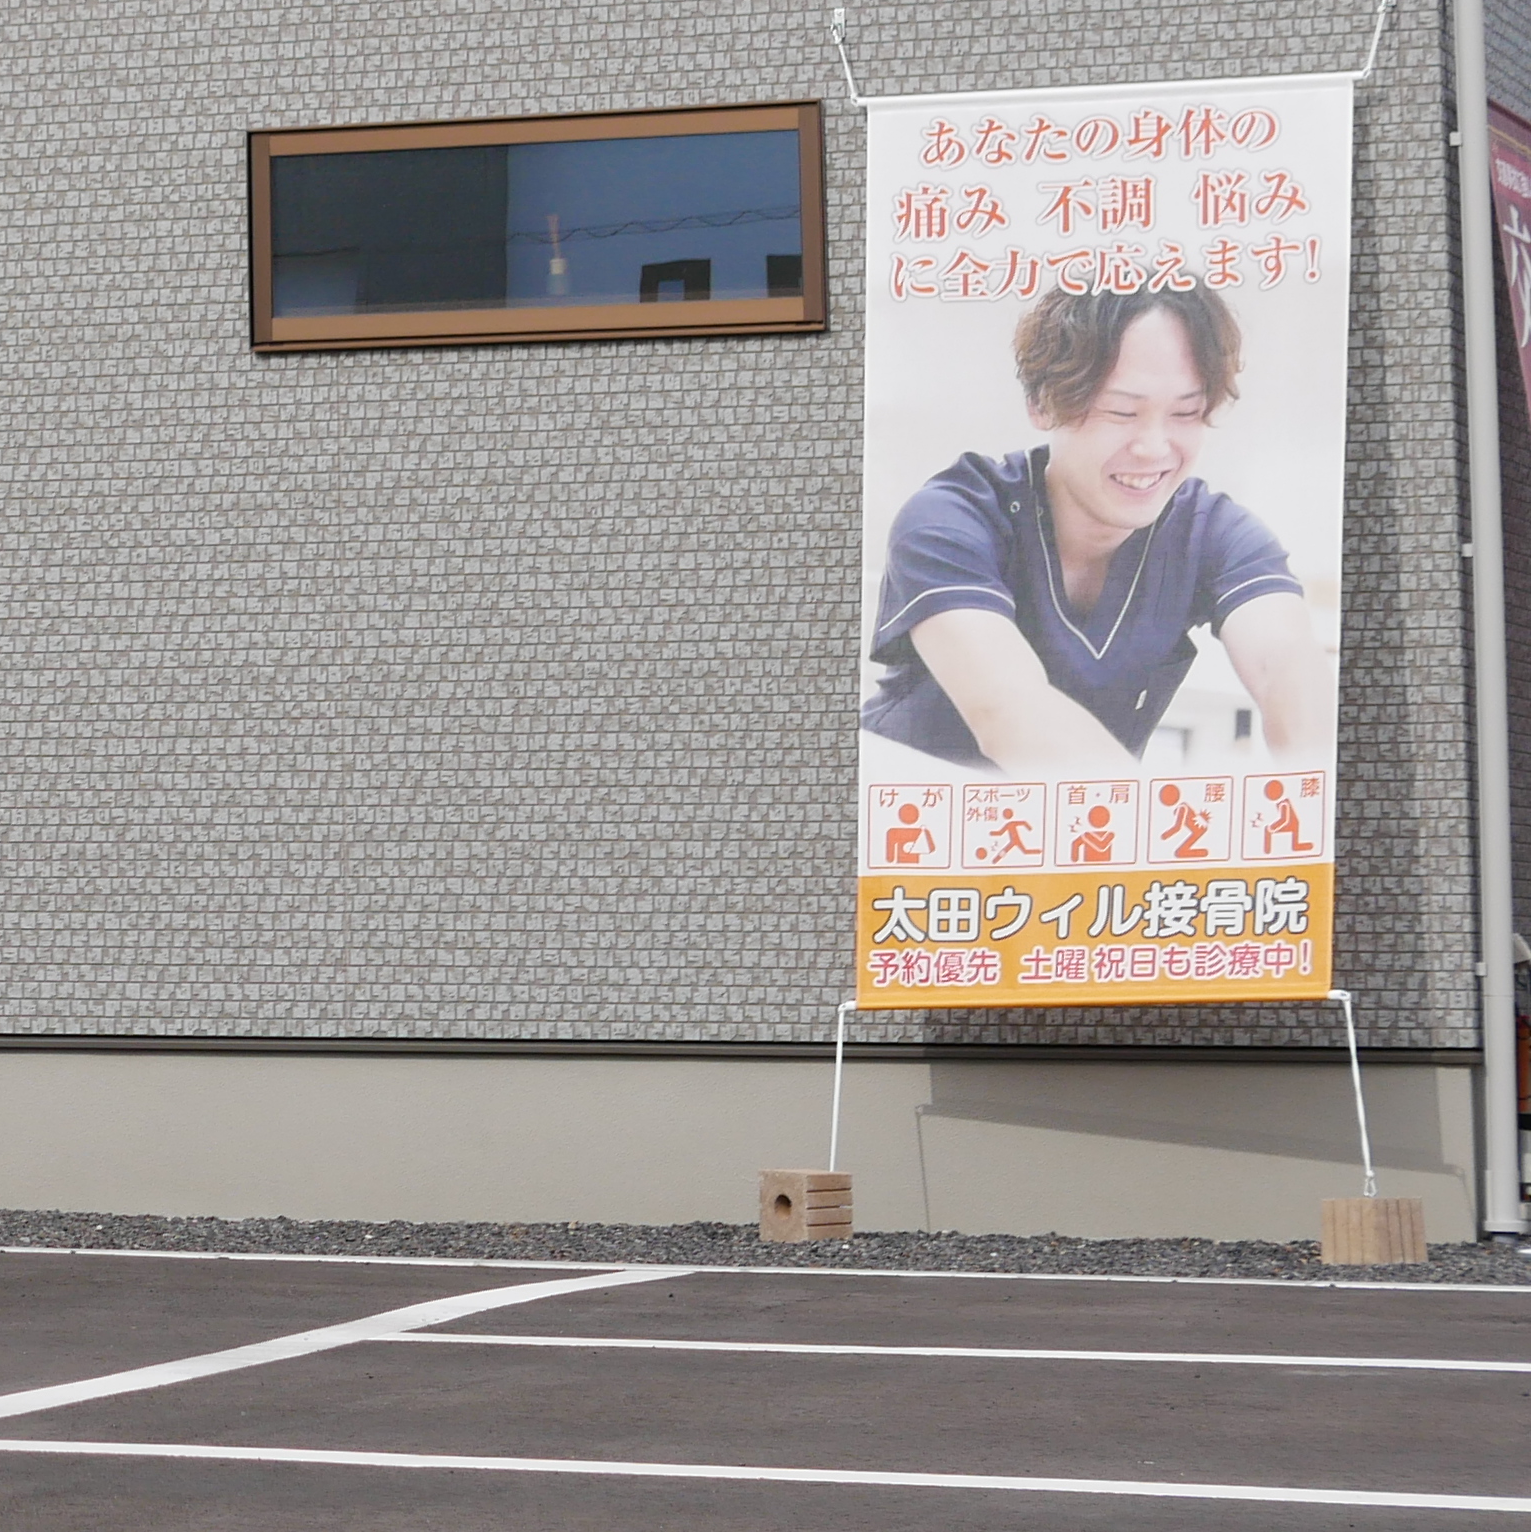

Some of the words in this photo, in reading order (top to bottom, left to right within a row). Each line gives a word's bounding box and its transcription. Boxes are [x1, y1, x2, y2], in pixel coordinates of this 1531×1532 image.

[922, 107, 1277, 165] あなたの身体の
[895, 187, 1006, 241] 痛み
[1039, 176, 1153, 234] 不調
[1195, 169, 1307, 226] 悩み
[967, 788, 1031, 803] スポーツ
[1067, 784, 1131, 805] 首・肩
[1204, 783, 1226, 802] 腰
[1300, 778, 1320, 798] 膝
[873, 878, 1309, 944] 太田ウィル接骨院
[870, 949, 999, 984] 予約優先
